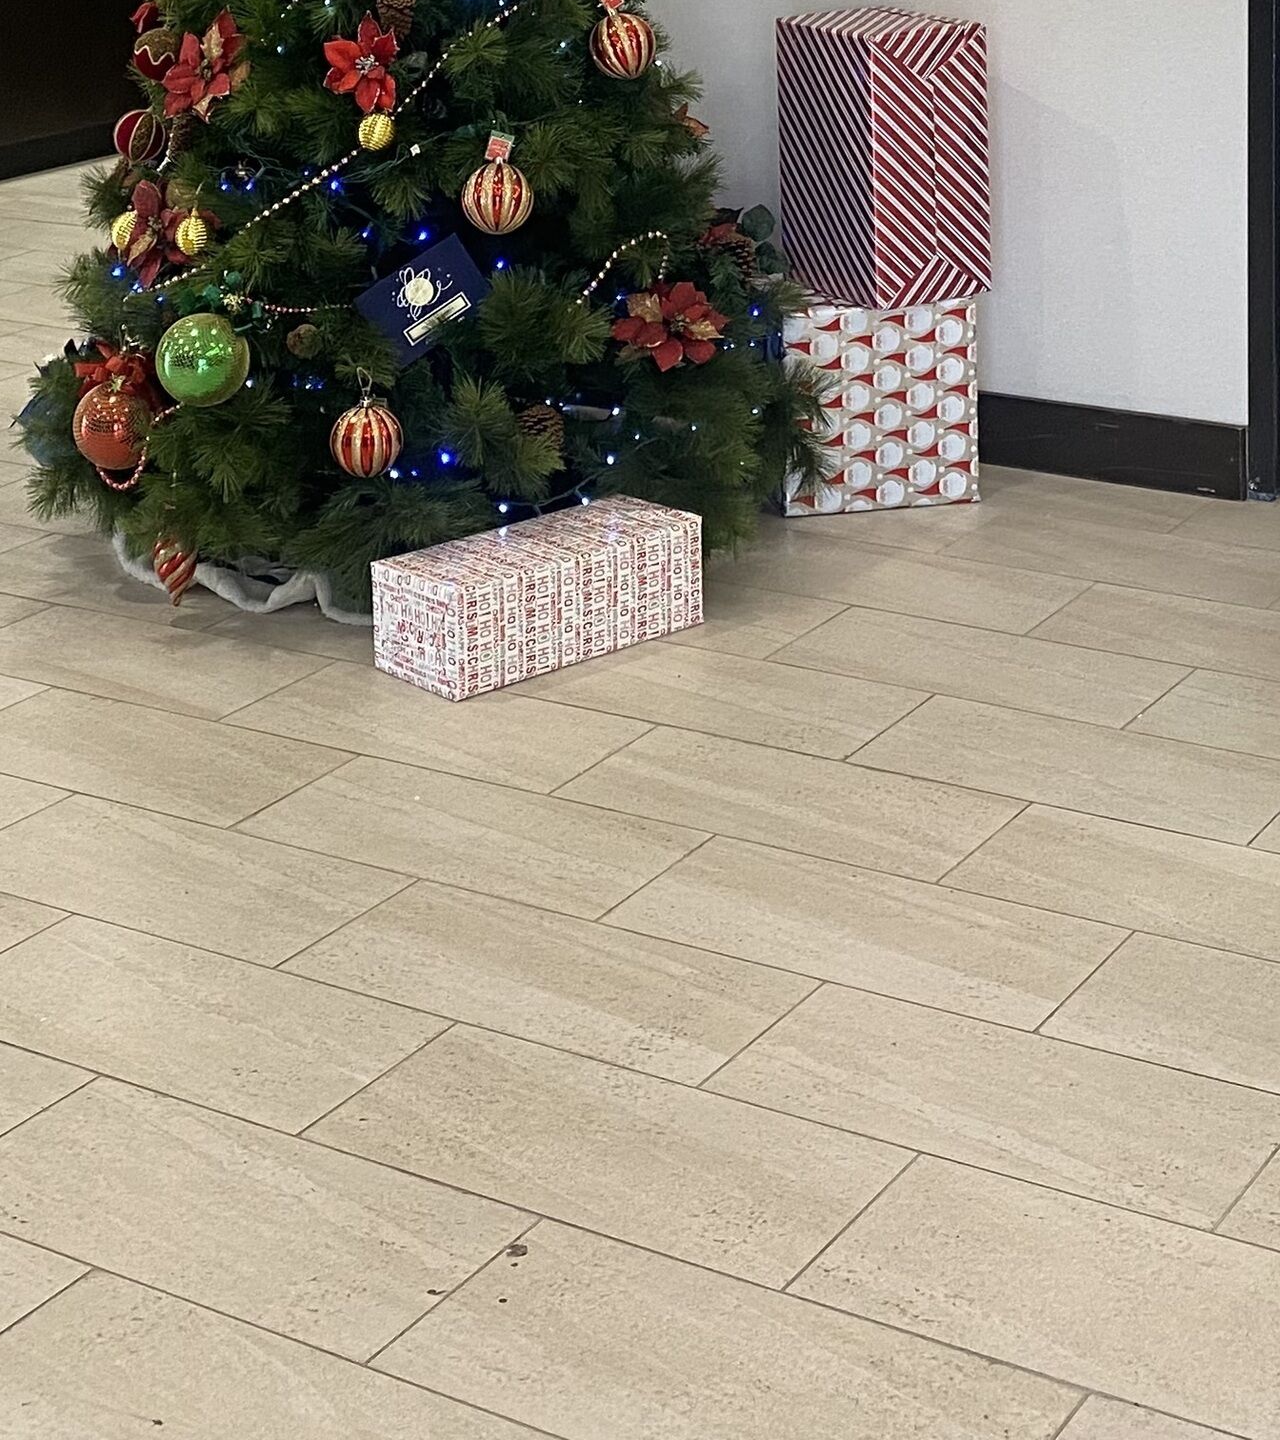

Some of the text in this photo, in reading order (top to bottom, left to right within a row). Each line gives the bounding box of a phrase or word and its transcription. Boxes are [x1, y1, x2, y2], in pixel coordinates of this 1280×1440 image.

[673, 583, 682, 601] HO
[620, 599, 629, 617] HO
[690, 588, 700, 623] CHRIS
[563, 615, 573, 634] HO
[637, 604, 647, 640] CHRIS
[507, 633, 516, 652] HO
